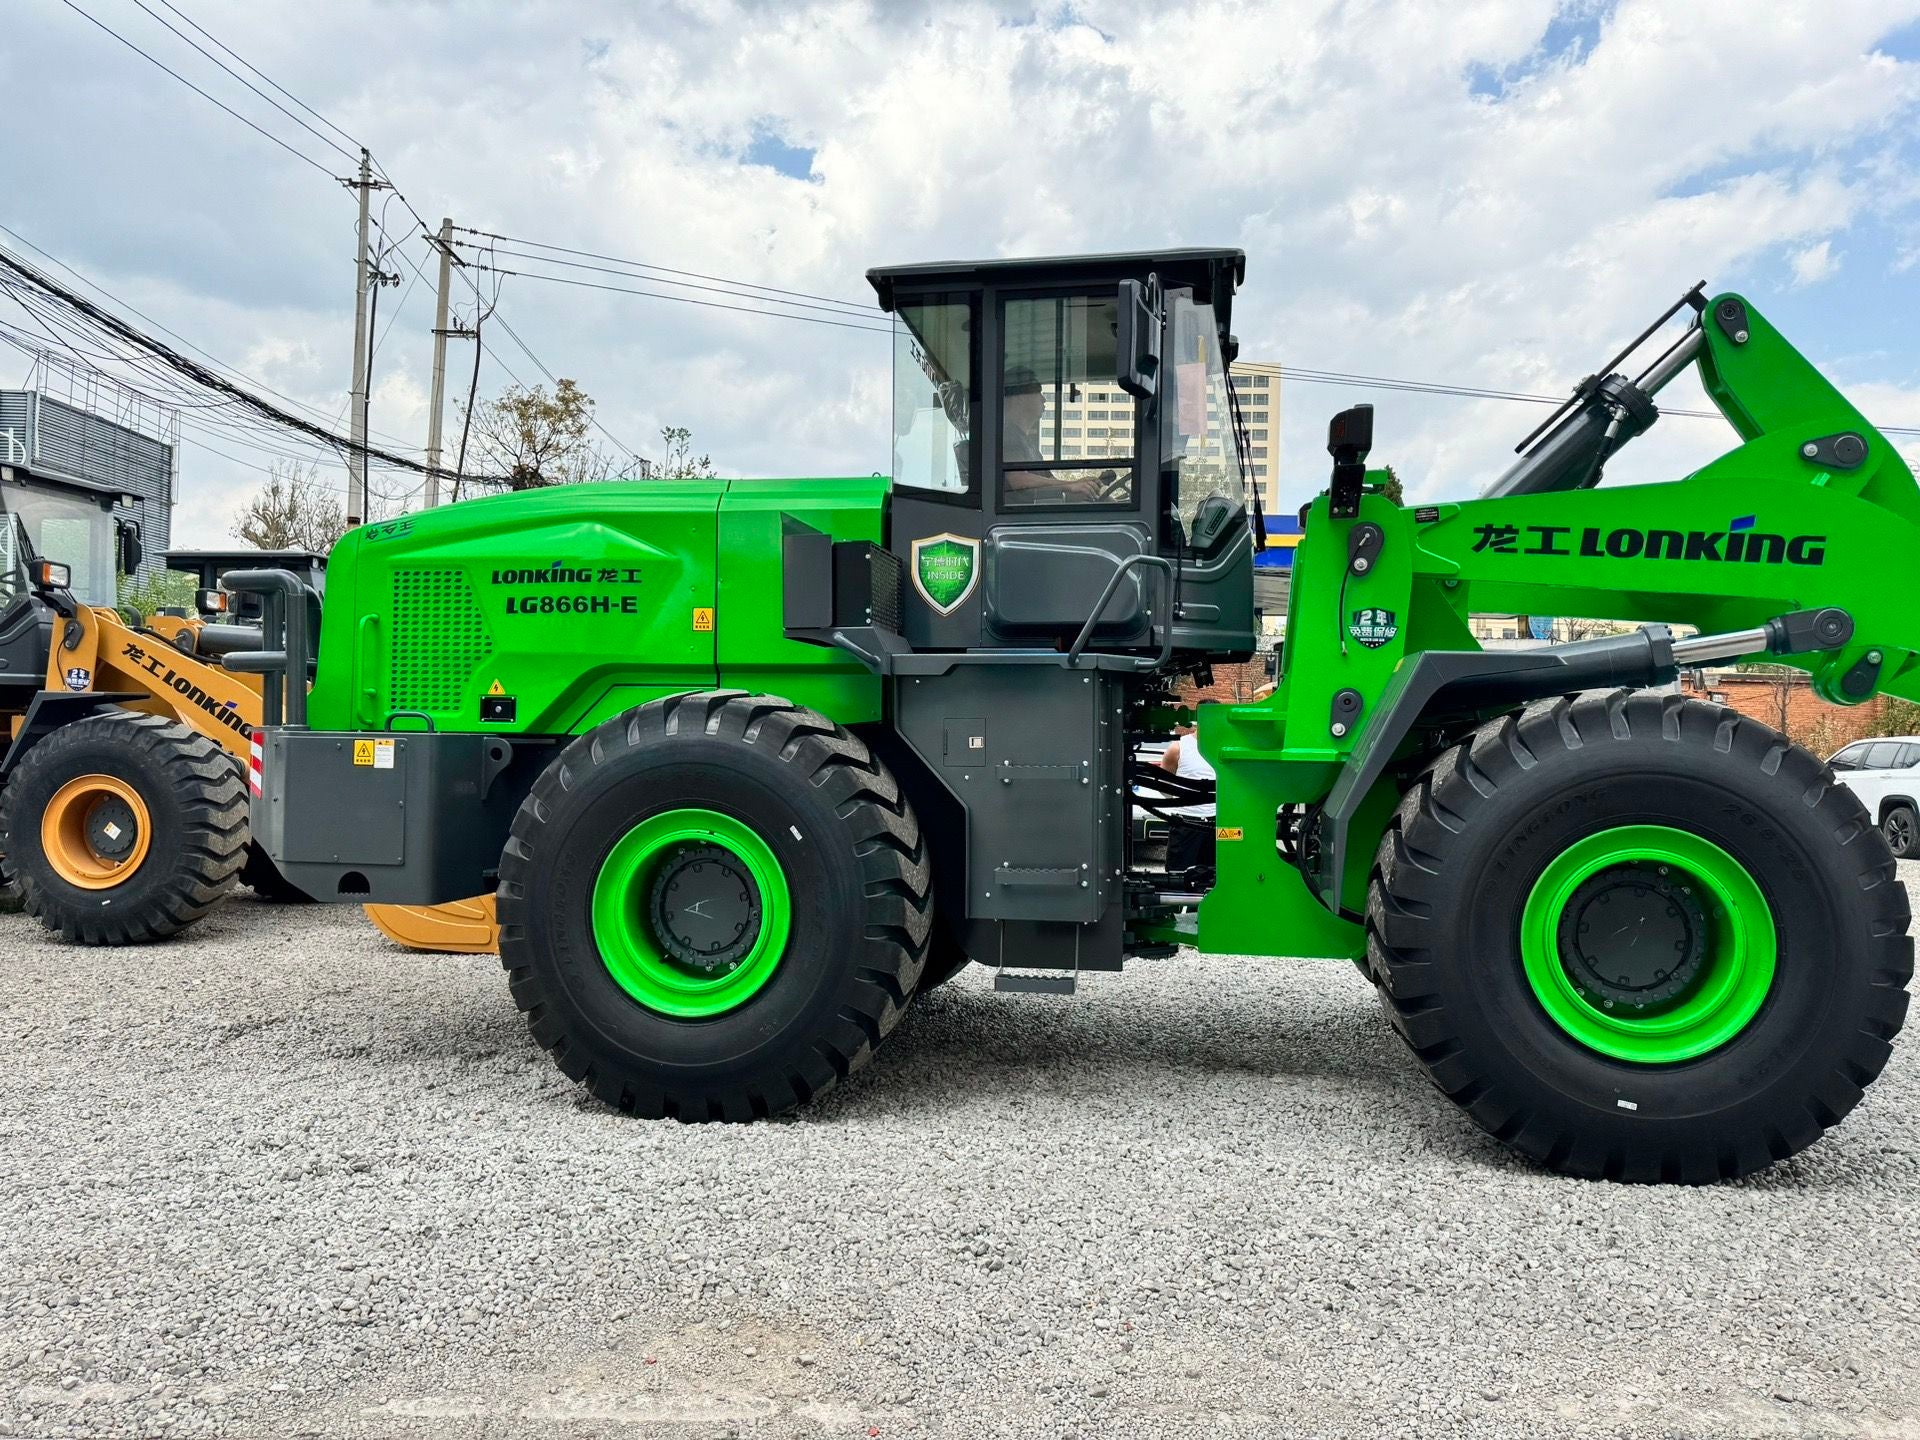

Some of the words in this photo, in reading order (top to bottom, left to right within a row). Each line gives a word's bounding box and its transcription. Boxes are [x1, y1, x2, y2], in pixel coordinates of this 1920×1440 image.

[1471, 523, 1571, 555] 龙工
[596, 568, 643, 584] 龙工
[927, 570, 965, 580] INSIDE
[505, 595, 638, 615] LG866H-E
[1359, 609, 1388, 626] 2年
[122, 642, 165, 678] 龙工
